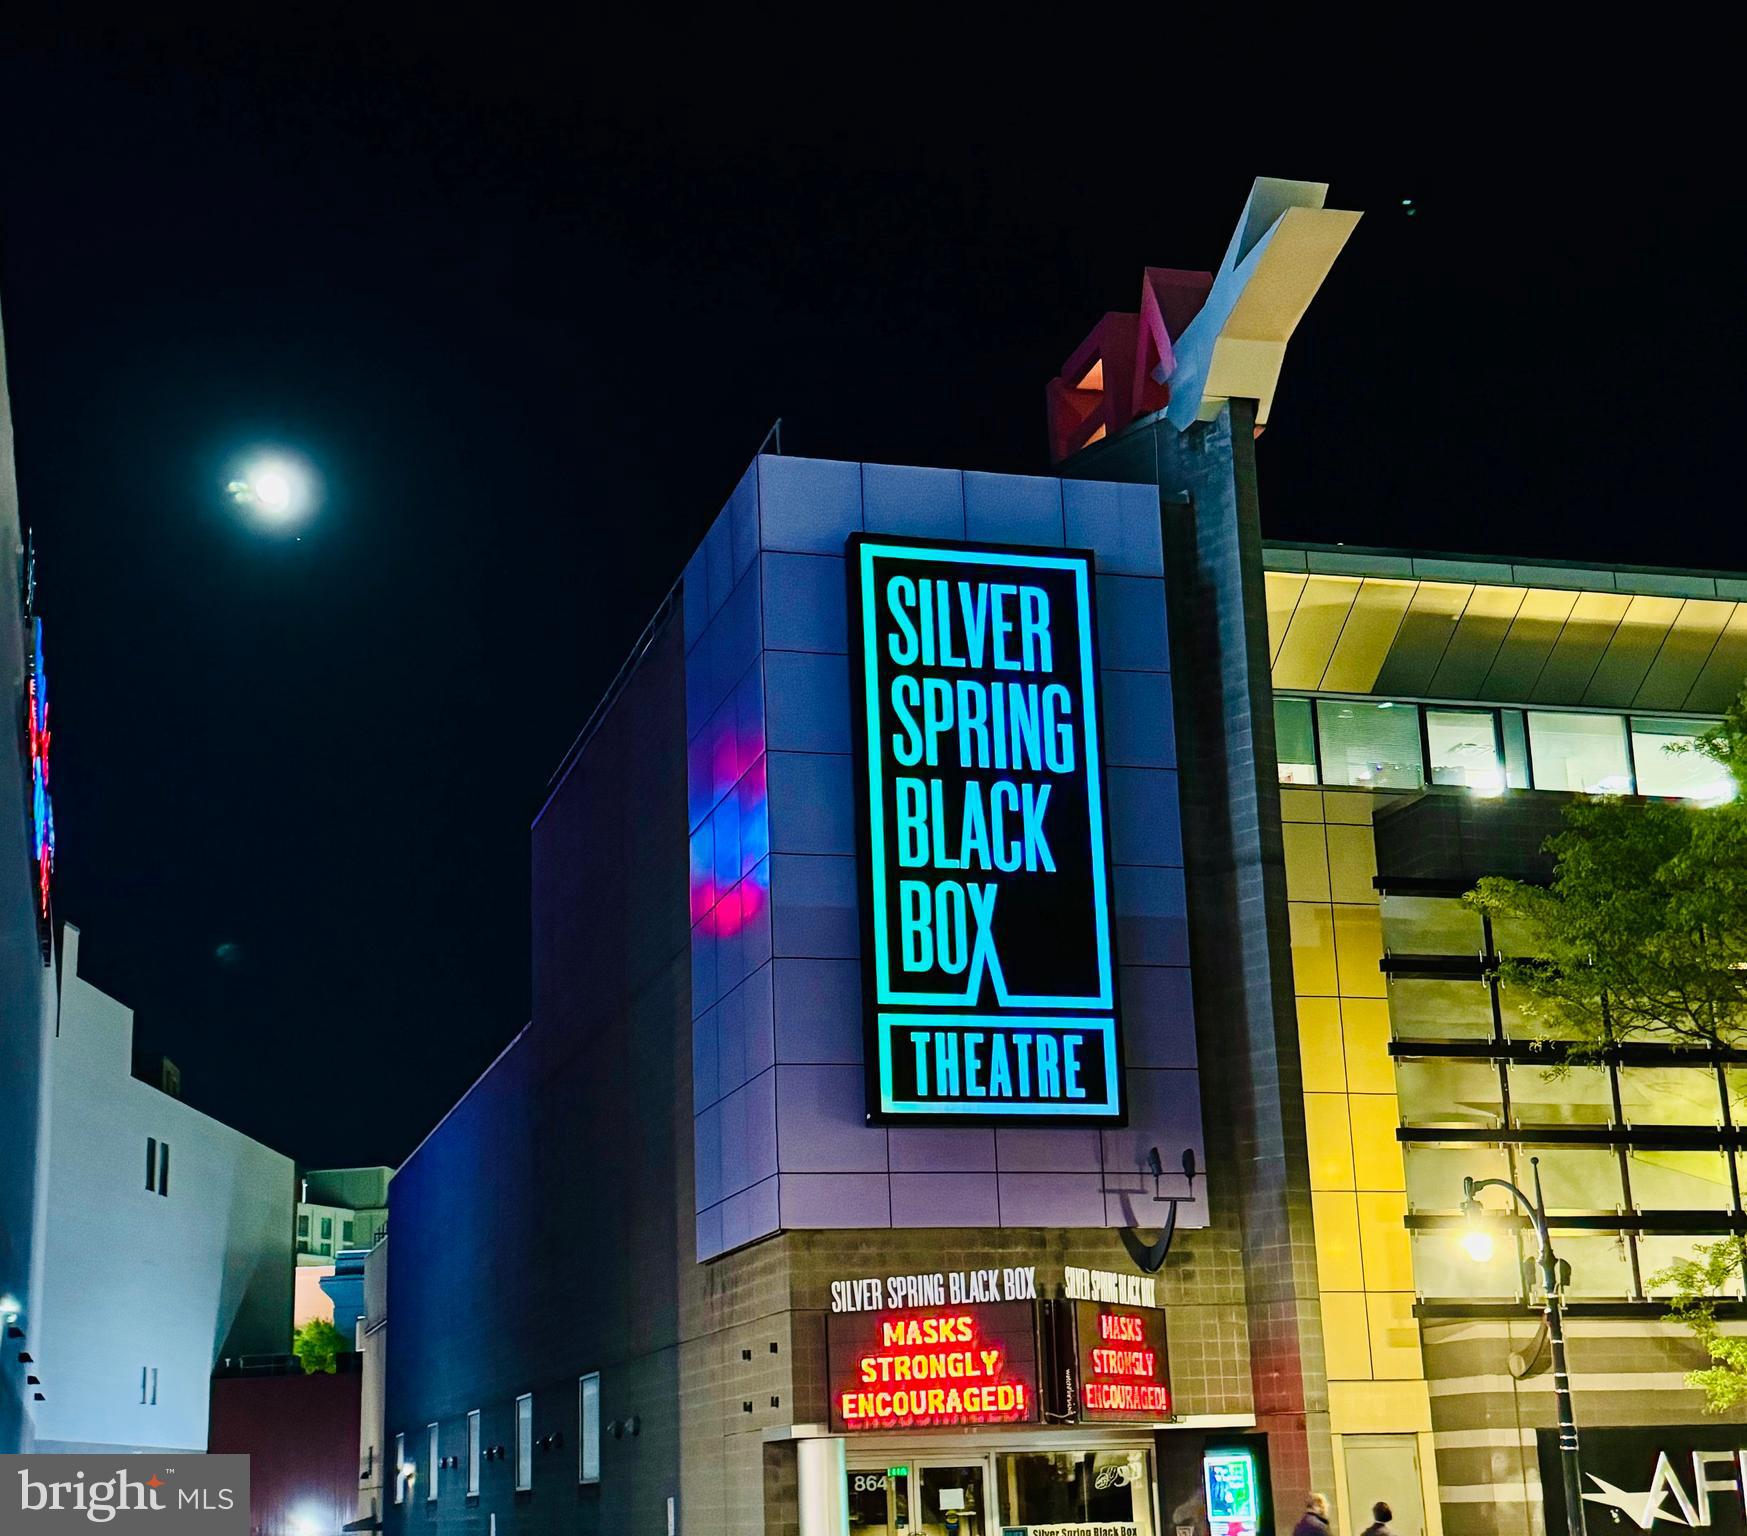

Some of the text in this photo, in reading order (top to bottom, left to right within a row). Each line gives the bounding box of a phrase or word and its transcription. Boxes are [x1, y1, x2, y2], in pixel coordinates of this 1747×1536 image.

[887, 575, 1053, 673] SILVER
[891, 675, 1076, 774] SPRING
[896, 777, 1057, 873] BLACK
[900, 880, 1003, 1006] BOX
[910, 1032, 1086, 1098] THEATRE
[831, 1267, 1037, 1313] SILVER SPRING BLACK BOX
[882, 1316, 973, 1347] MASKS
[1101, 1315, 1143, 1342] MASKS
[861, 1350, 999, 1383] STRONGLY
[1092, 1349, 1154, 1376] STRONGLY
[841, 1384, 1025, 1419] ENCOURAGED!
[1085, 1383, 1167, 1410] ENCOURAGED!
